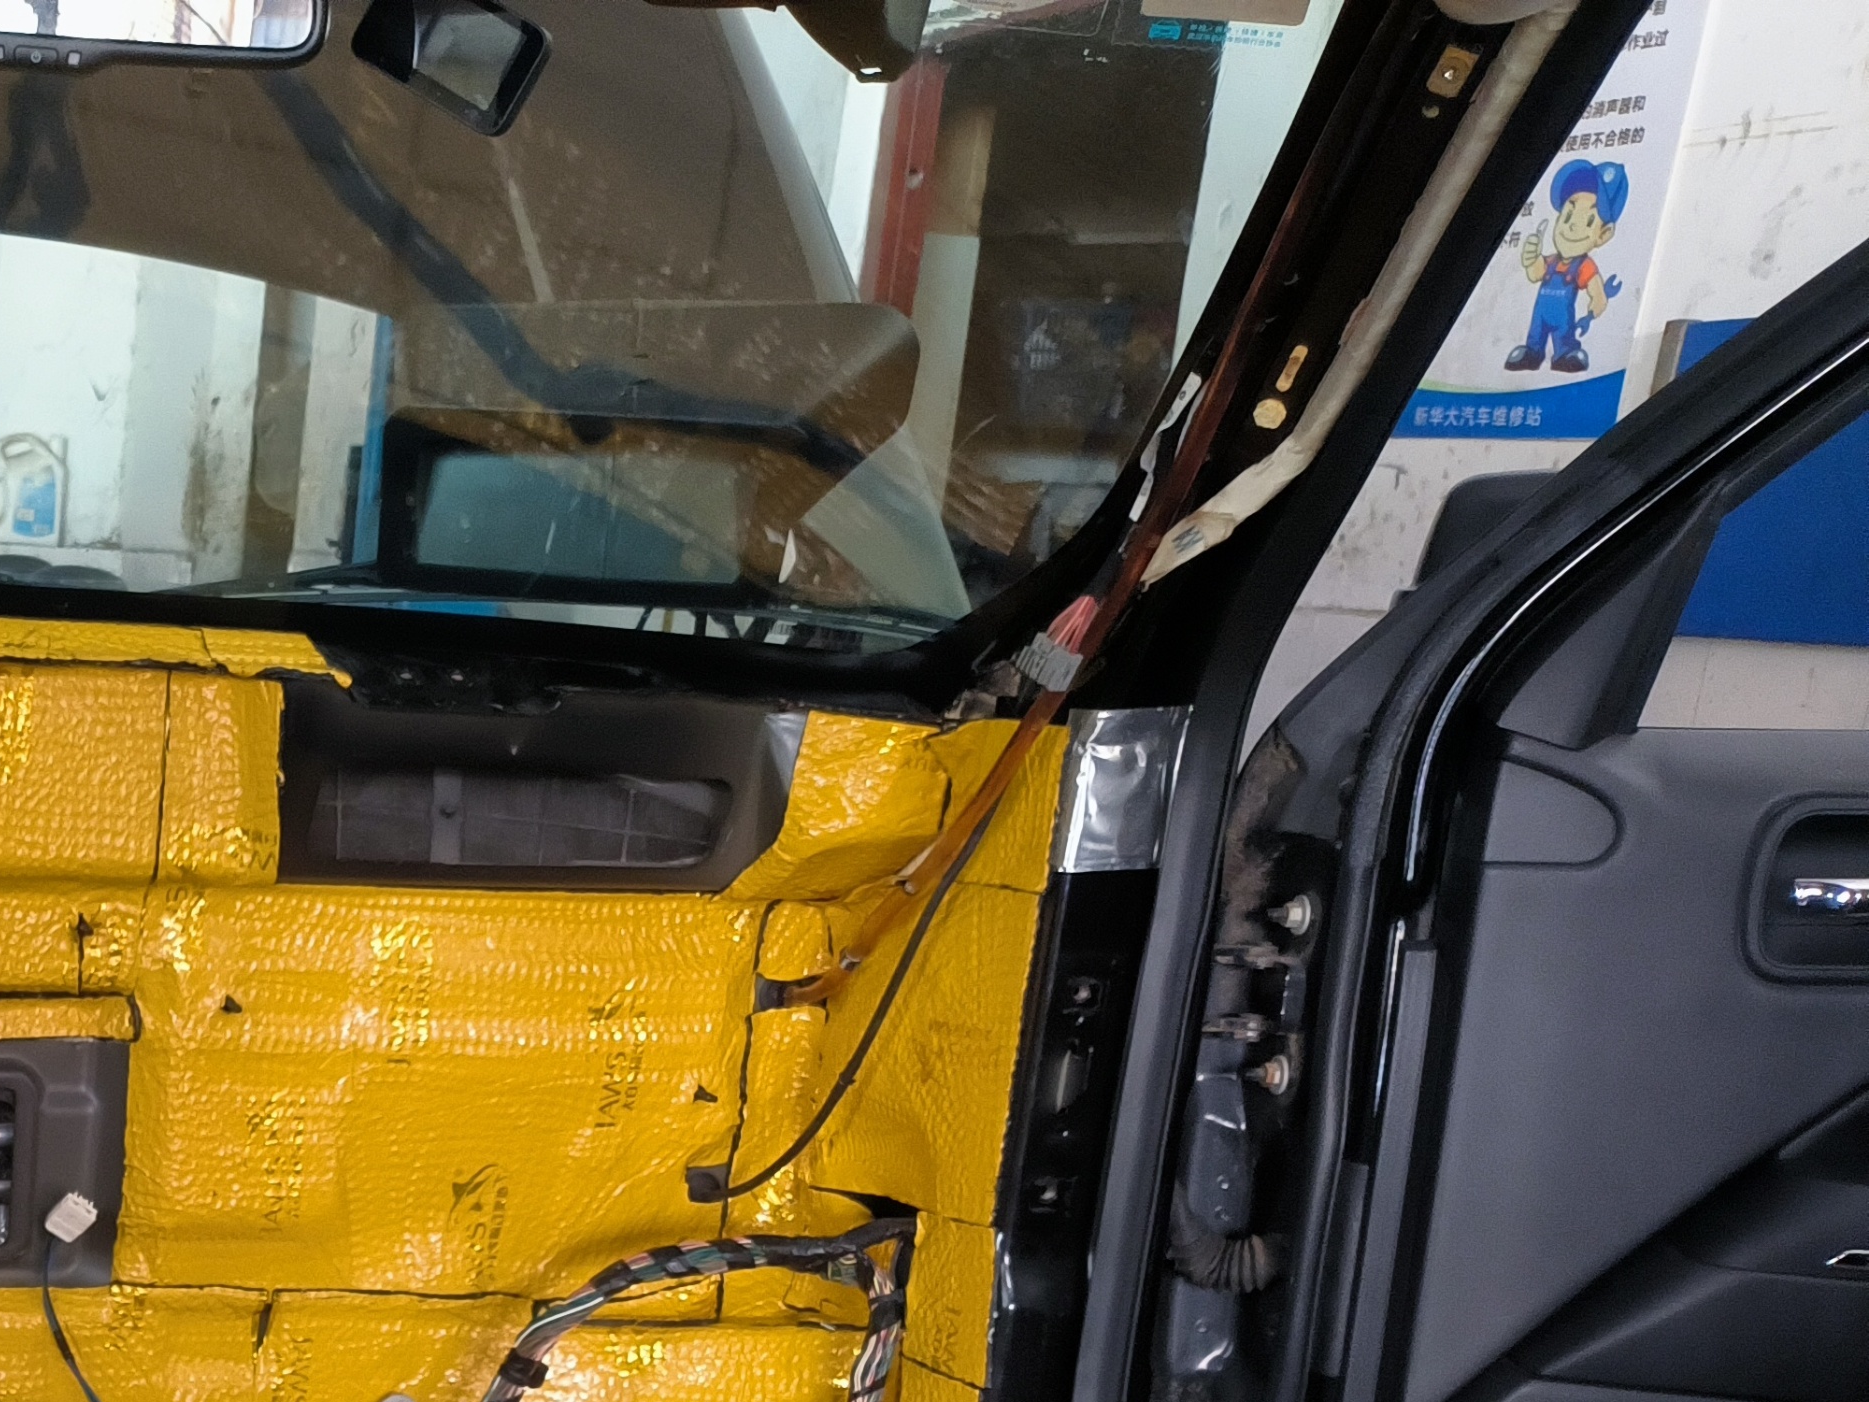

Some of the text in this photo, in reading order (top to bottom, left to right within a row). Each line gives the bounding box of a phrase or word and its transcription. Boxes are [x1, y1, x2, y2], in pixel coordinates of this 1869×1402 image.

[1623, 29, 1669, 52] 作业过
[1560, 126, 1645, 153] 使用不合格的
[1414, 405, 1543, 427] 新华大汽车维修站
